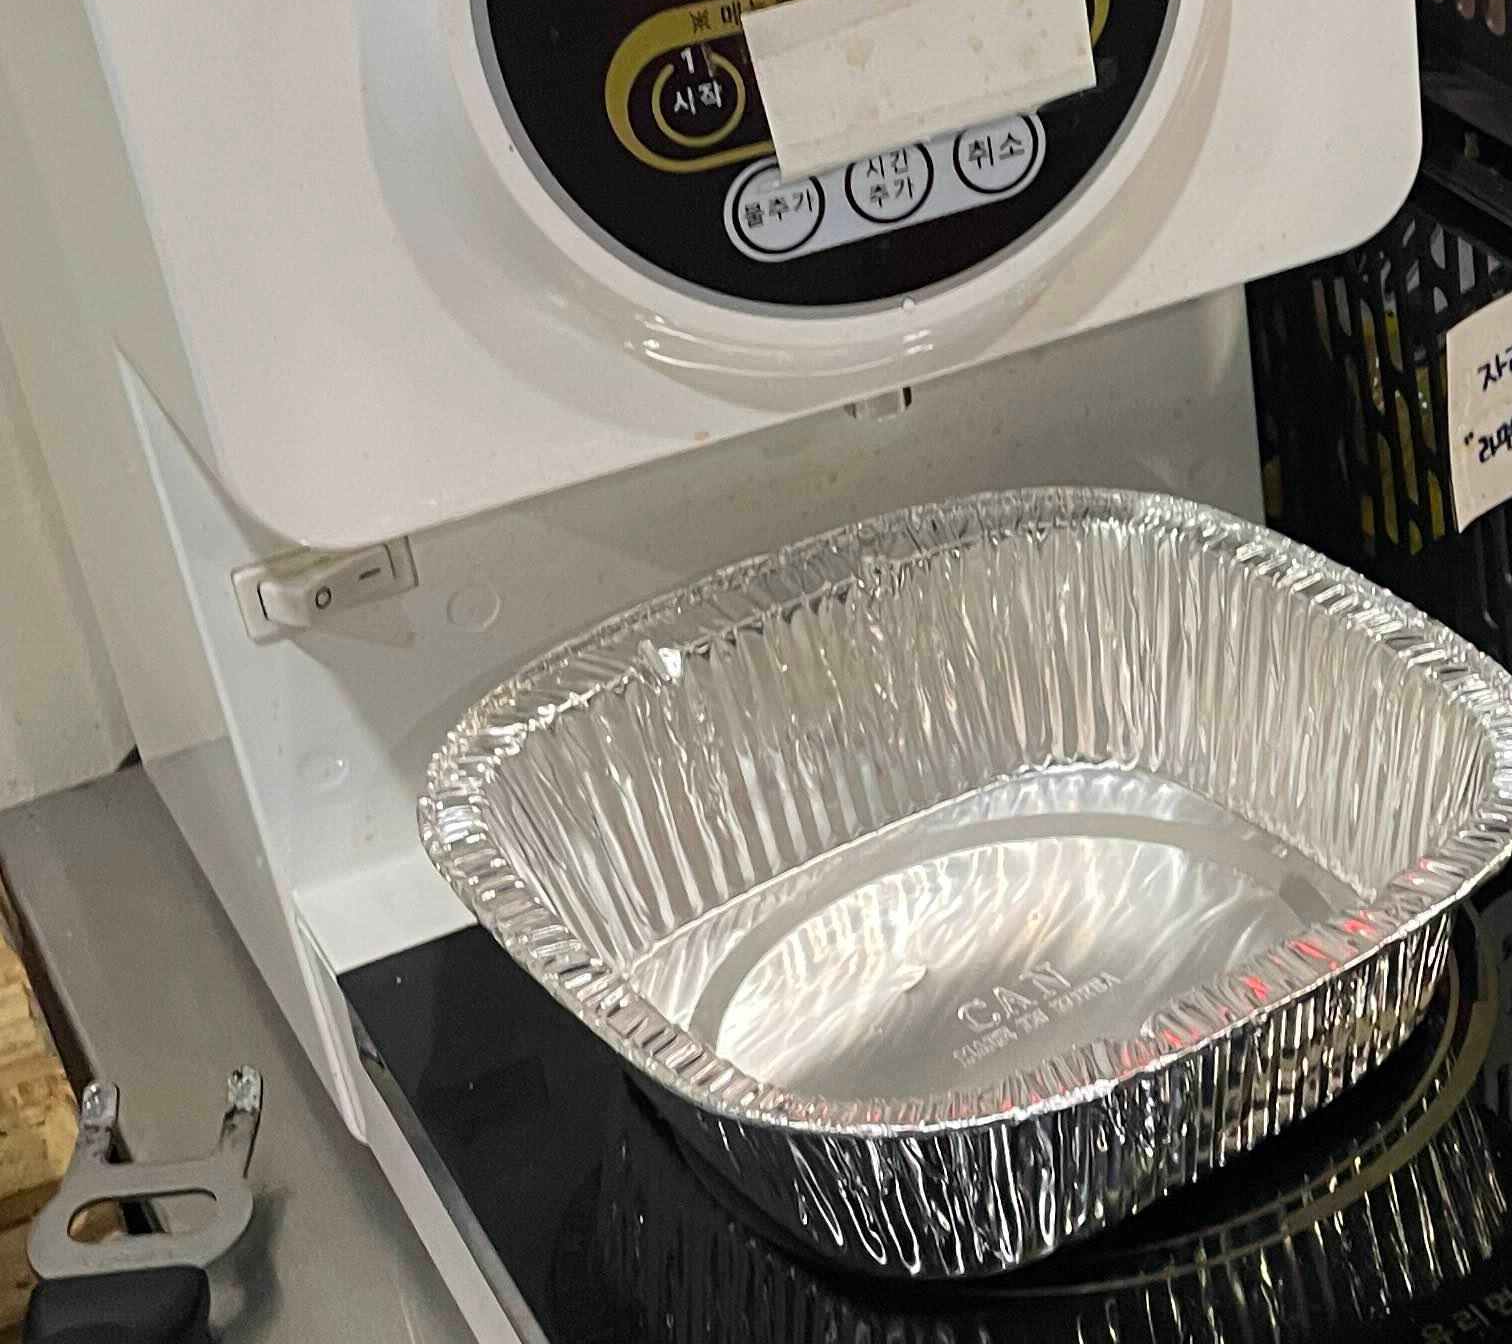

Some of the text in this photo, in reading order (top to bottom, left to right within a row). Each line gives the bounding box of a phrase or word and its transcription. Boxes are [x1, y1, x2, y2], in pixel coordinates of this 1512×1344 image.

[673, 80, 722, 116] 시작
[866, 148, 909, 179] 시간
[967, 132, 1025, 170] 취소
